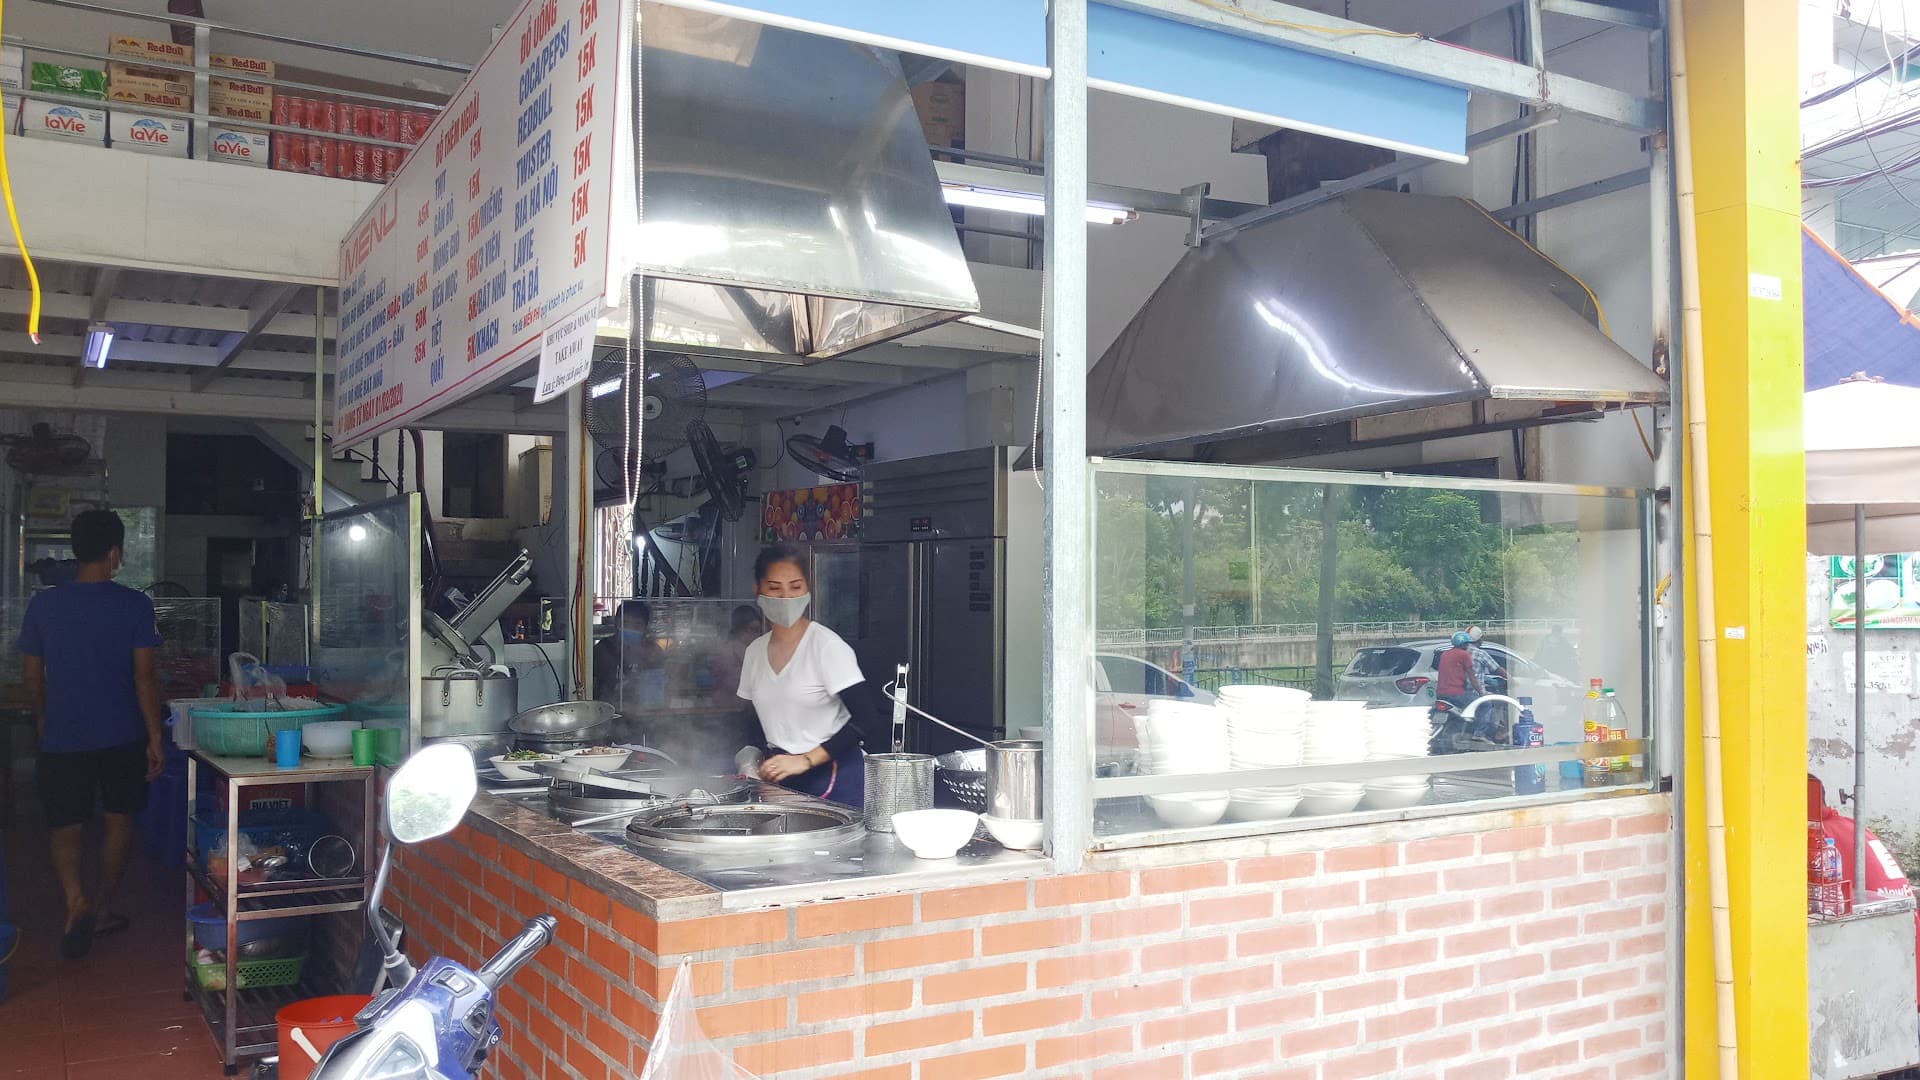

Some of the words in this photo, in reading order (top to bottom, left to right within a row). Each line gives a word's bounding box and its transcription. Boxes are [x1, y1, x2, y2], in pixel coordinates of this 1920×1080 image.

[147, 42, 165, 53] Red
[166, 45, 184, 56] Bull
[519, 19, 570, 105] COCA/PEPSI
[580, 0, 598, 35] 15K
[232, 58, 249, 69] Red
[250, 60, 266, 71] Bull
[144, 93, 162, 103] Red
[163, 95, 181, 106] Bull
[229, 82, 246, 93] Red
[247, 84, 264, 95] Bull
[517, 83, 552, 148] REDBULL
[578, 32, 597, 82] 15K
[45, 116, 86, 133] laVie
[226, 107, 244, 117] Red
[244, 109, 262, 120] Bull
[130, 127, 169, 144] laVie
[214, 140, 250, 157] laVie
[470, 127, 482, 162] 15K
[517, 129, 552, 190] TWISTER
[576, 82, 595, 132] 15K
[469, 167, 481, 202] 15K
[515, 194, 528, 233] BIA
[529, 176, 541, 220] HÀ
[542, 161, 559, 209] NỘI
[573, 131, 592, 180] 15K
[345, 187, 399, 281] MENU
[513, 226, 535, 273] LAVIE
[571, 179, 590, 226] 15K
[512, 269, 526, 313] TRÀ
[574, 226, 588, 269] 5K
[415, 338, 427, 364] 35K
